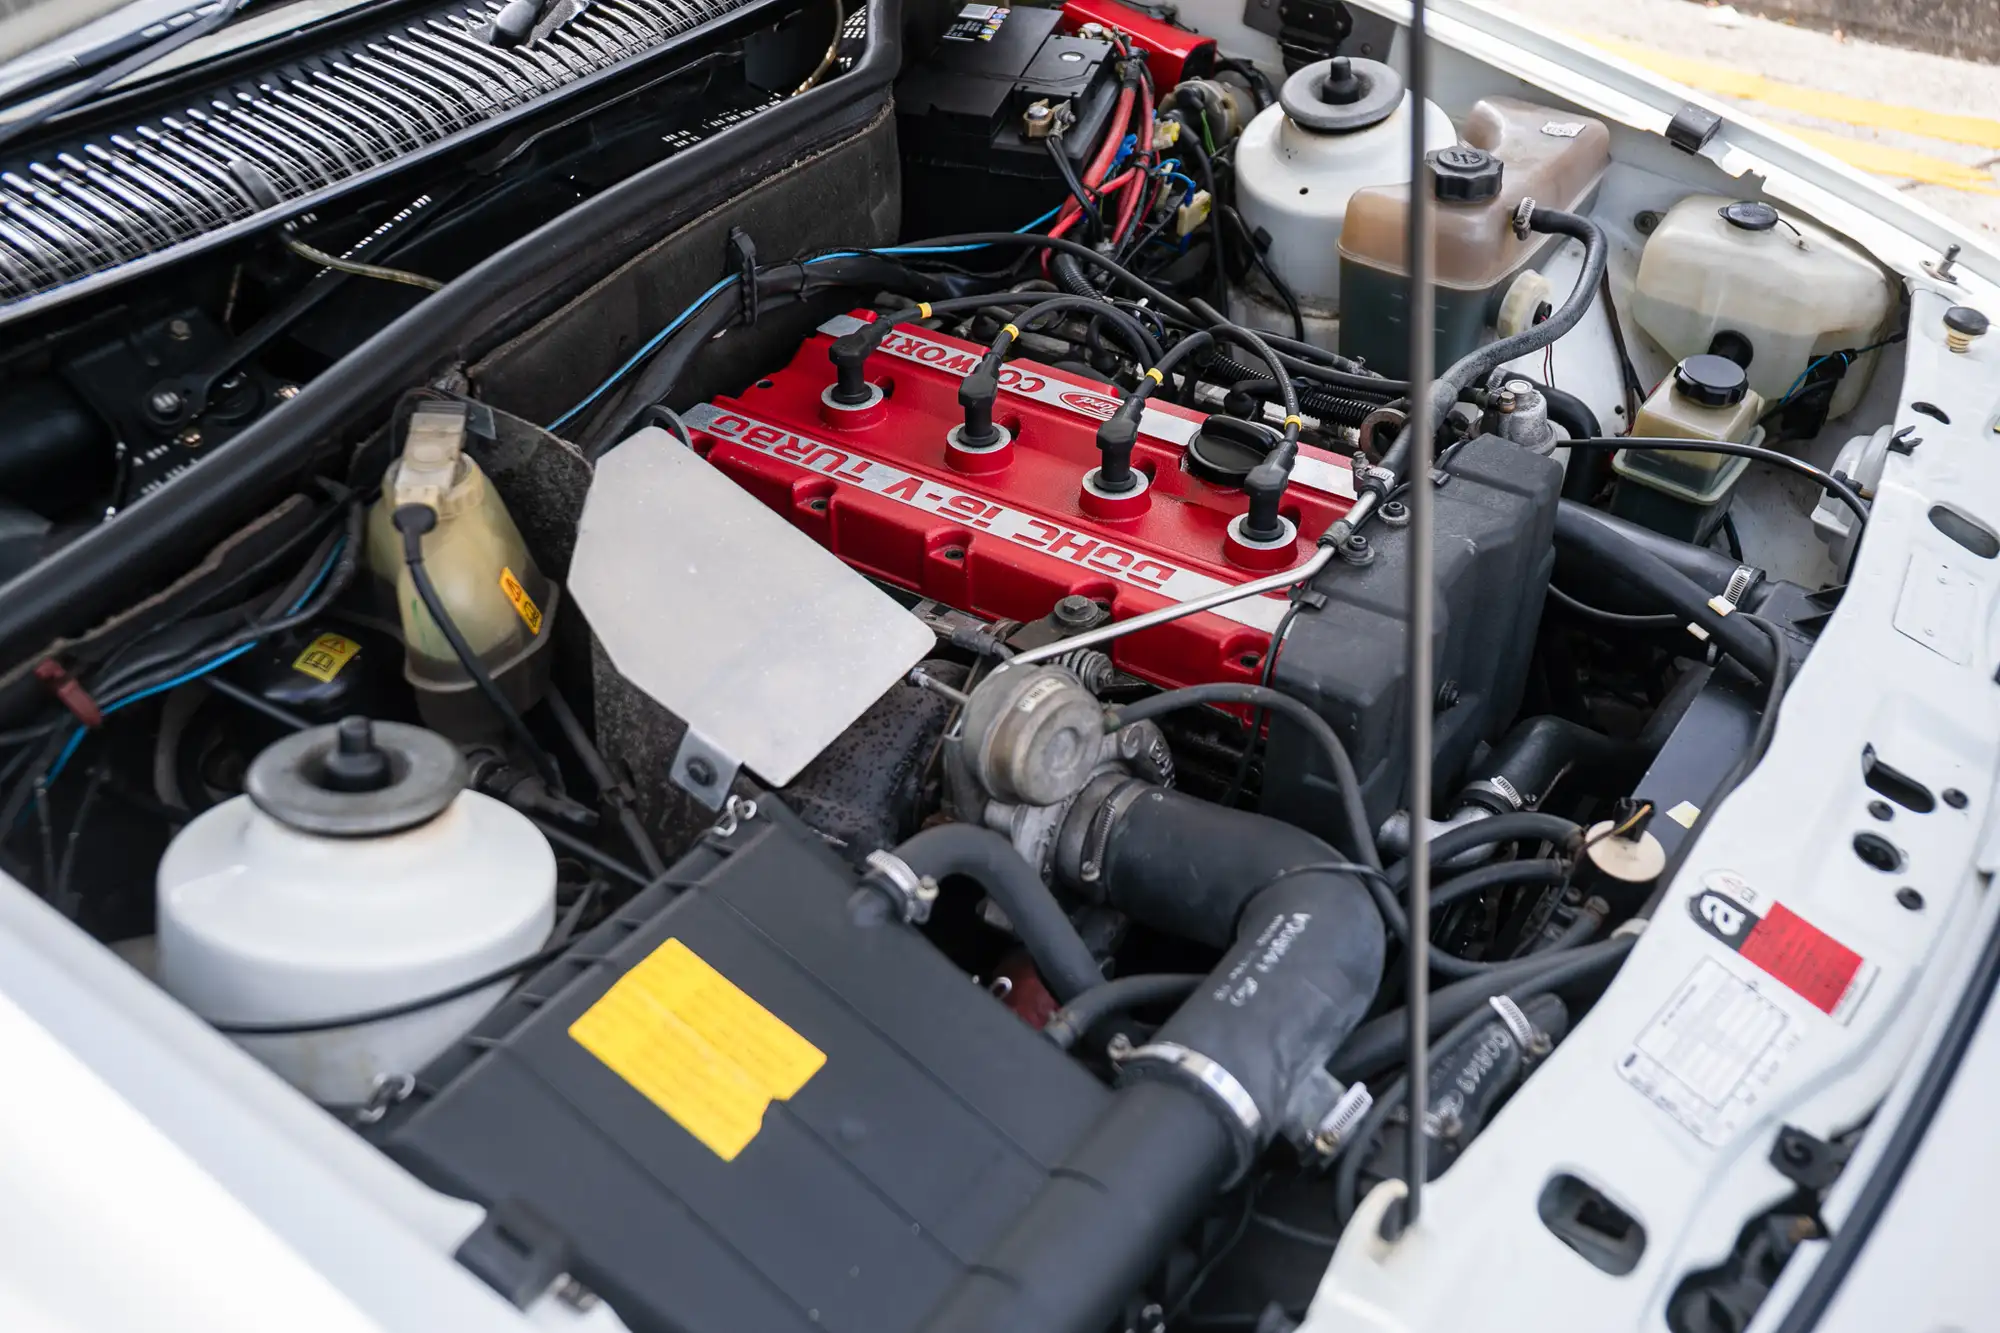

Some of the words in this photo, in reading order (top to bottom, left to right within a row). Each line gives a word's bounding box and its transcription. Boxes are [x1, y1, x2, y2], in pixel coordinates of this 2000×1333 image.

[880, 333, 1045, 393] COWORT
[1075, 395, 1119, 417] Ford
[708, 415, 872, 484] TURBO
[1012, 519, 1177, 589] DOHC
